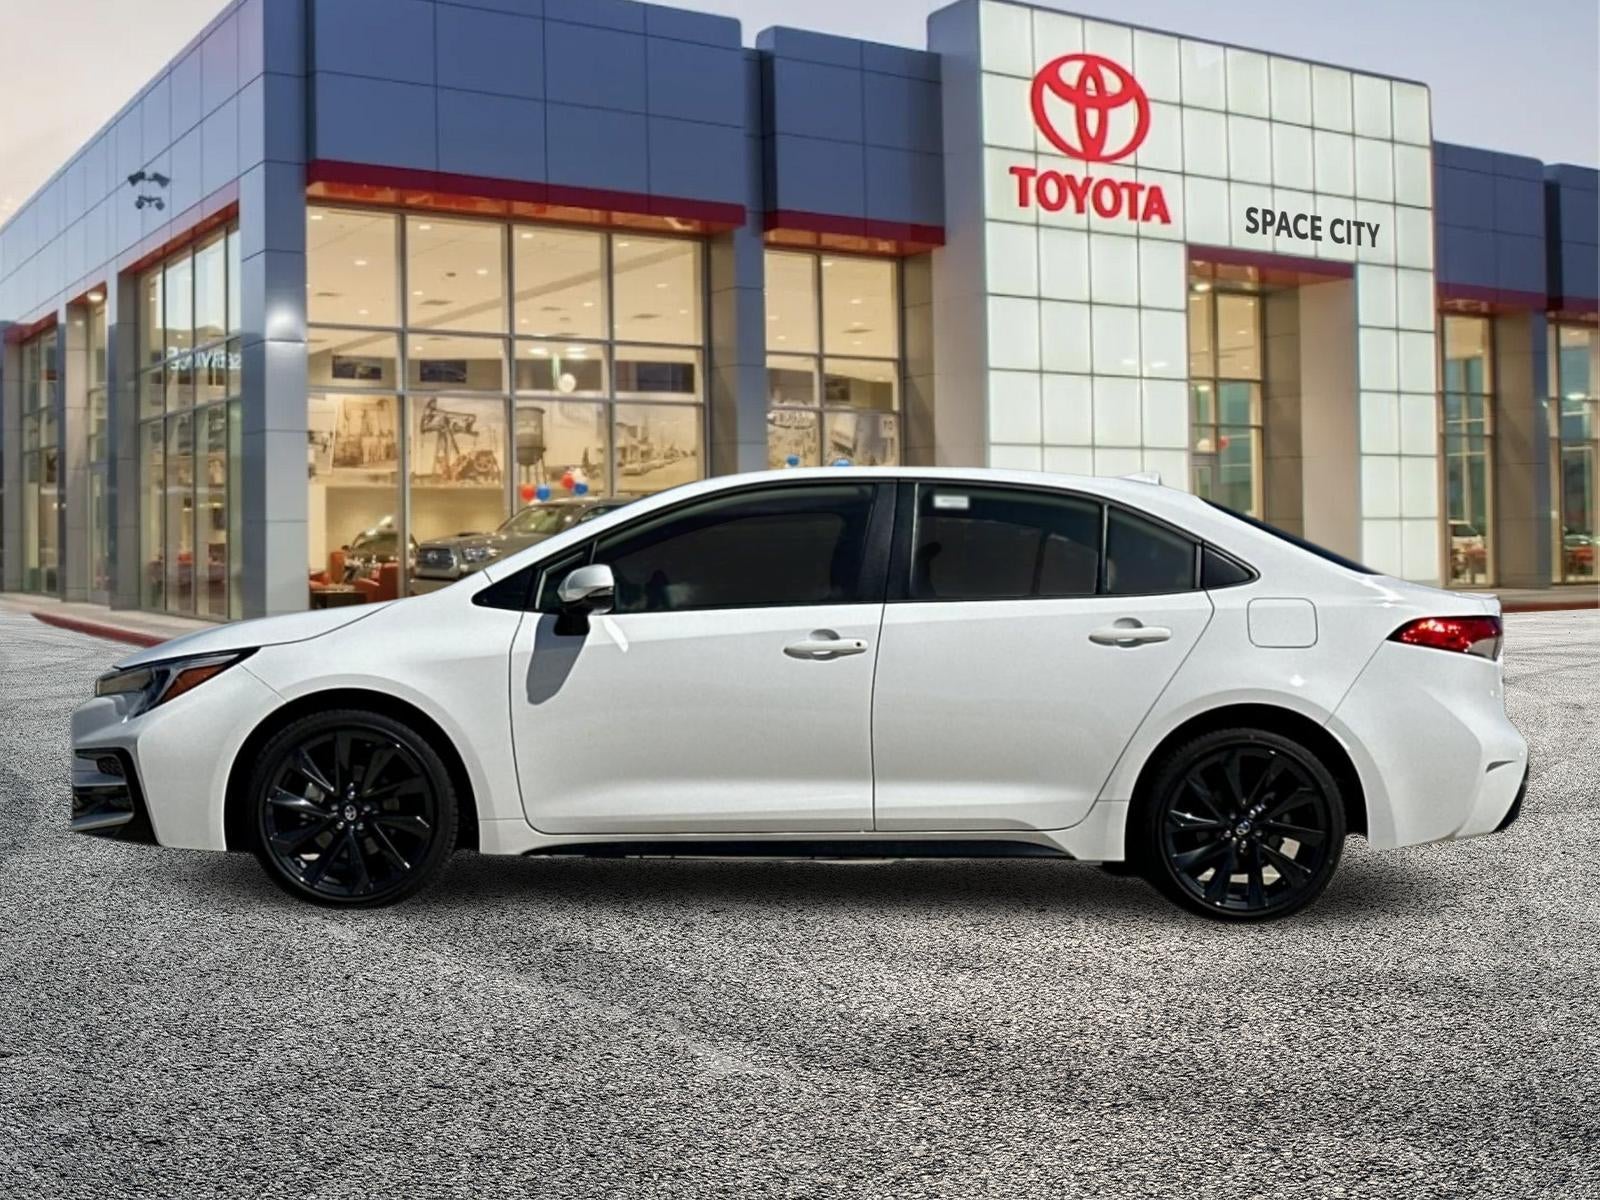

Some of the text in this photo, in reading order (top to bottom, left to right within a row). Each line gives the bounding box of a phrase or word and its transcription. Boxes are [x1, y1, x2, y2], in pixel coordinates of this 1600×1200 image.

[1009, 166, 1171, 225] TOYOTA
[1245, 206, 1381, 248] SPACE CITY
